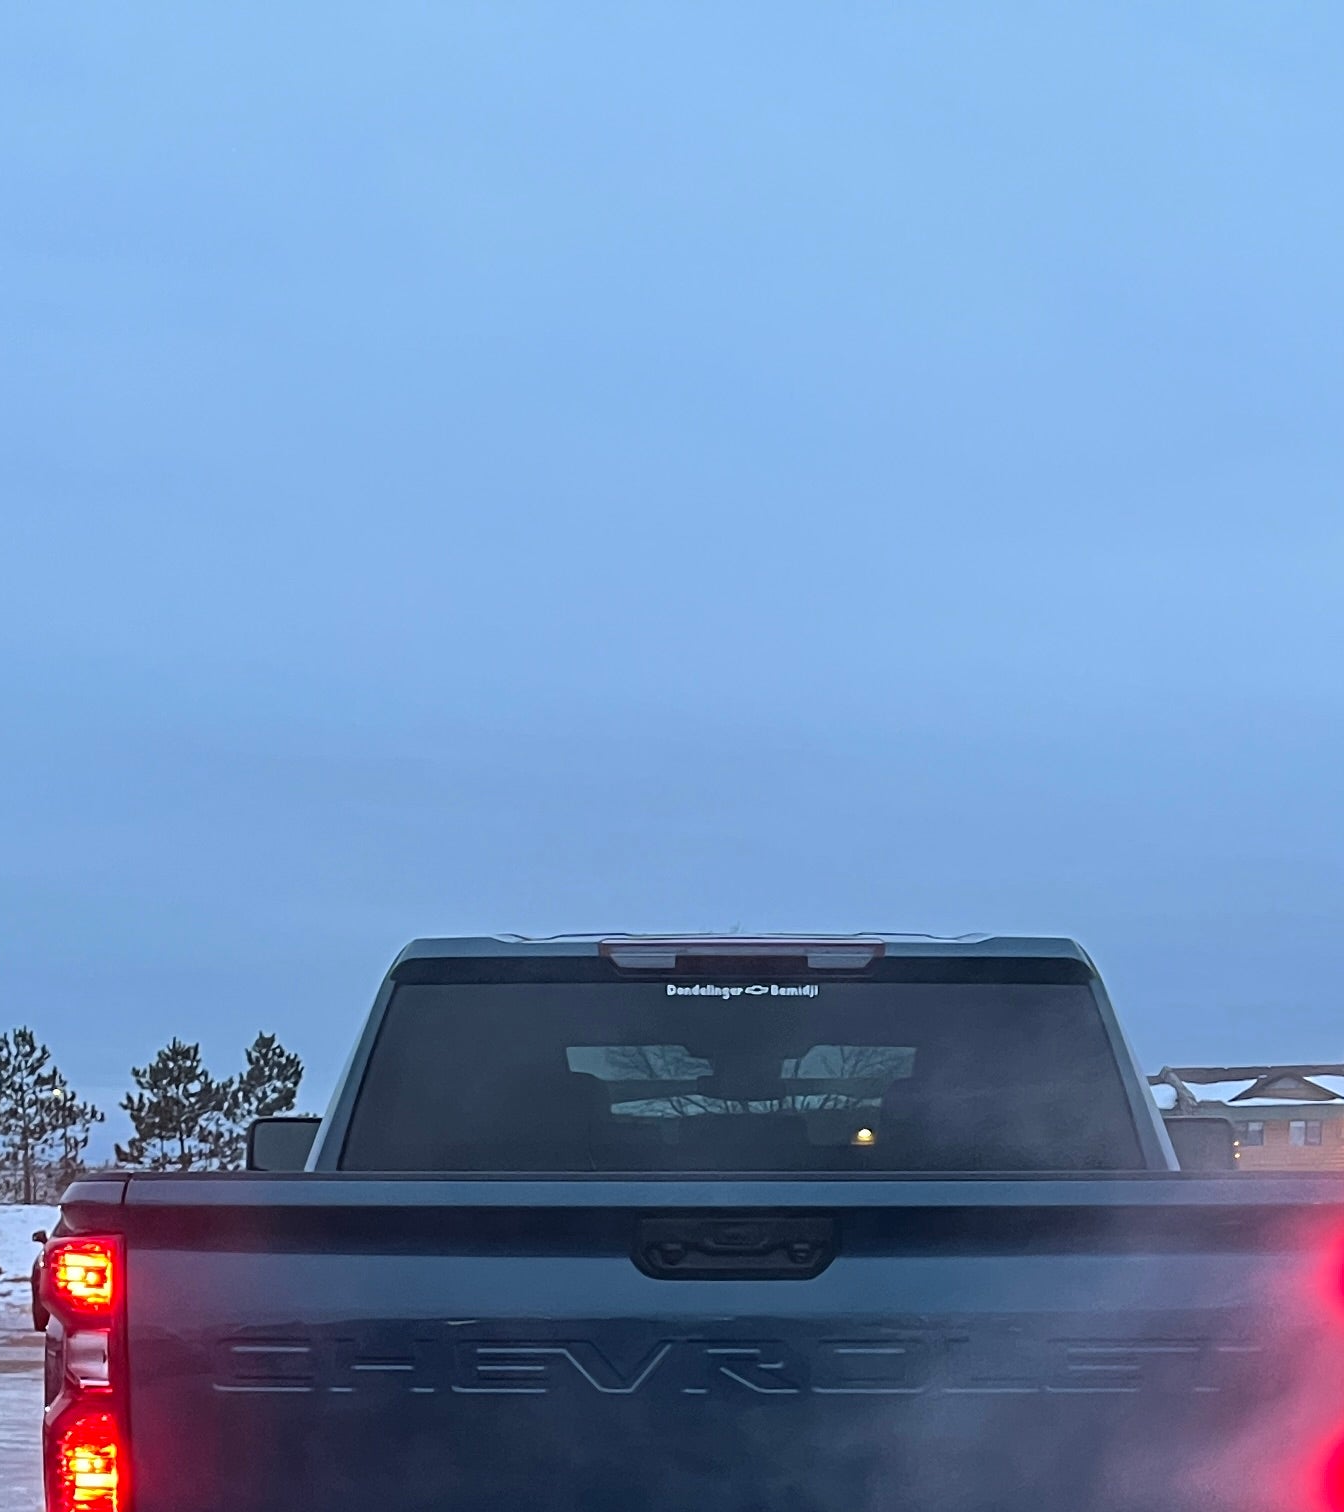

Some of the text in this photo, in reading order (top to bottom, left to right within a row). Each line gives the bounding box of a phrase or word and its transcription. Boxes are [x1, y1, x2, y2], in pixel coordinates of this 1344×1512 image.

[666, 984, 819, 1000] Dondelinger Bemidji
[212, 1338, 1266, 1394] CHEVROLET
